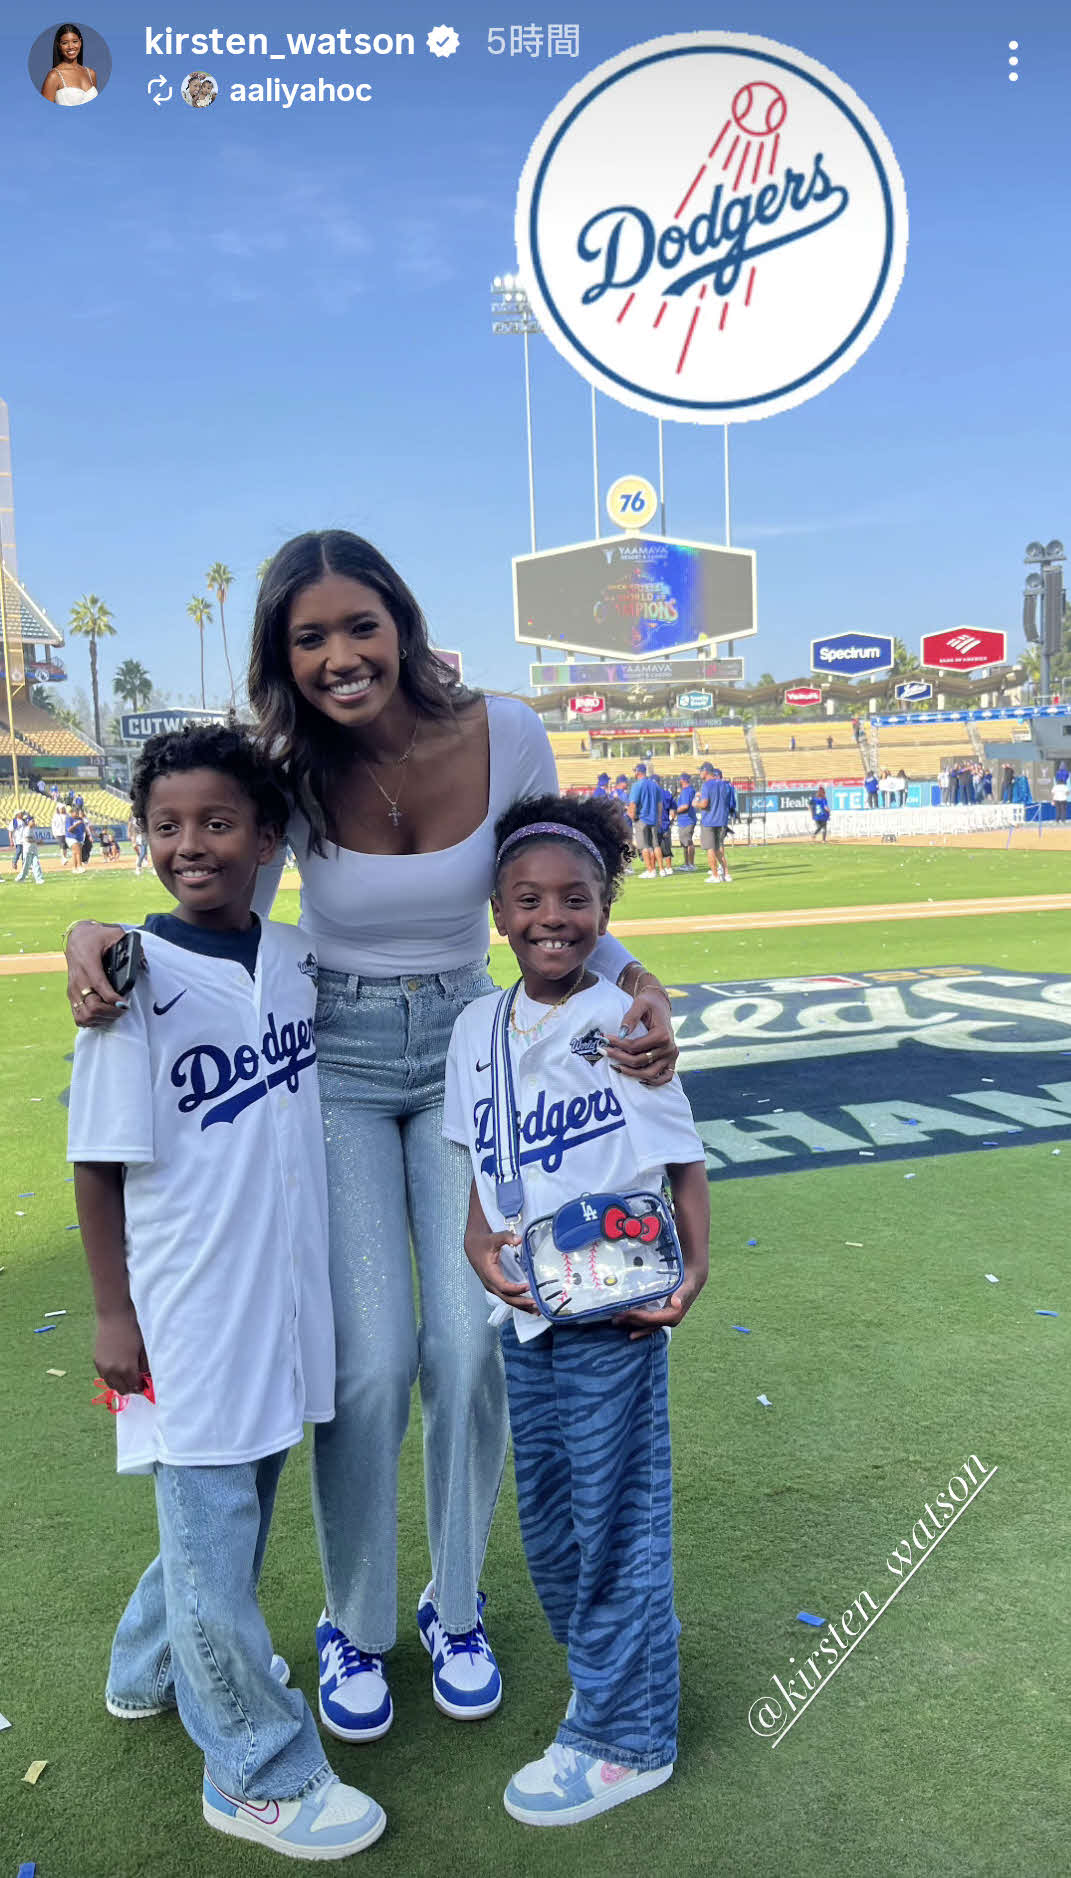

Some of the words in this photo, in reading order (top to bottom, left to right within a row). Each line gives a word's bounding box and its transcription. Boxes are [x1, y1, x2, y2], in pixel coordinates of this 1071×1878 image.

[620, 490, 645, 512] 76
[819, 646, 880, 663] Spectrum
[171, 1011, 317, 1131] Dodge
[474, 1087, 626, 1174] Ddgers
[580, 1200, 598, 1221] LA
